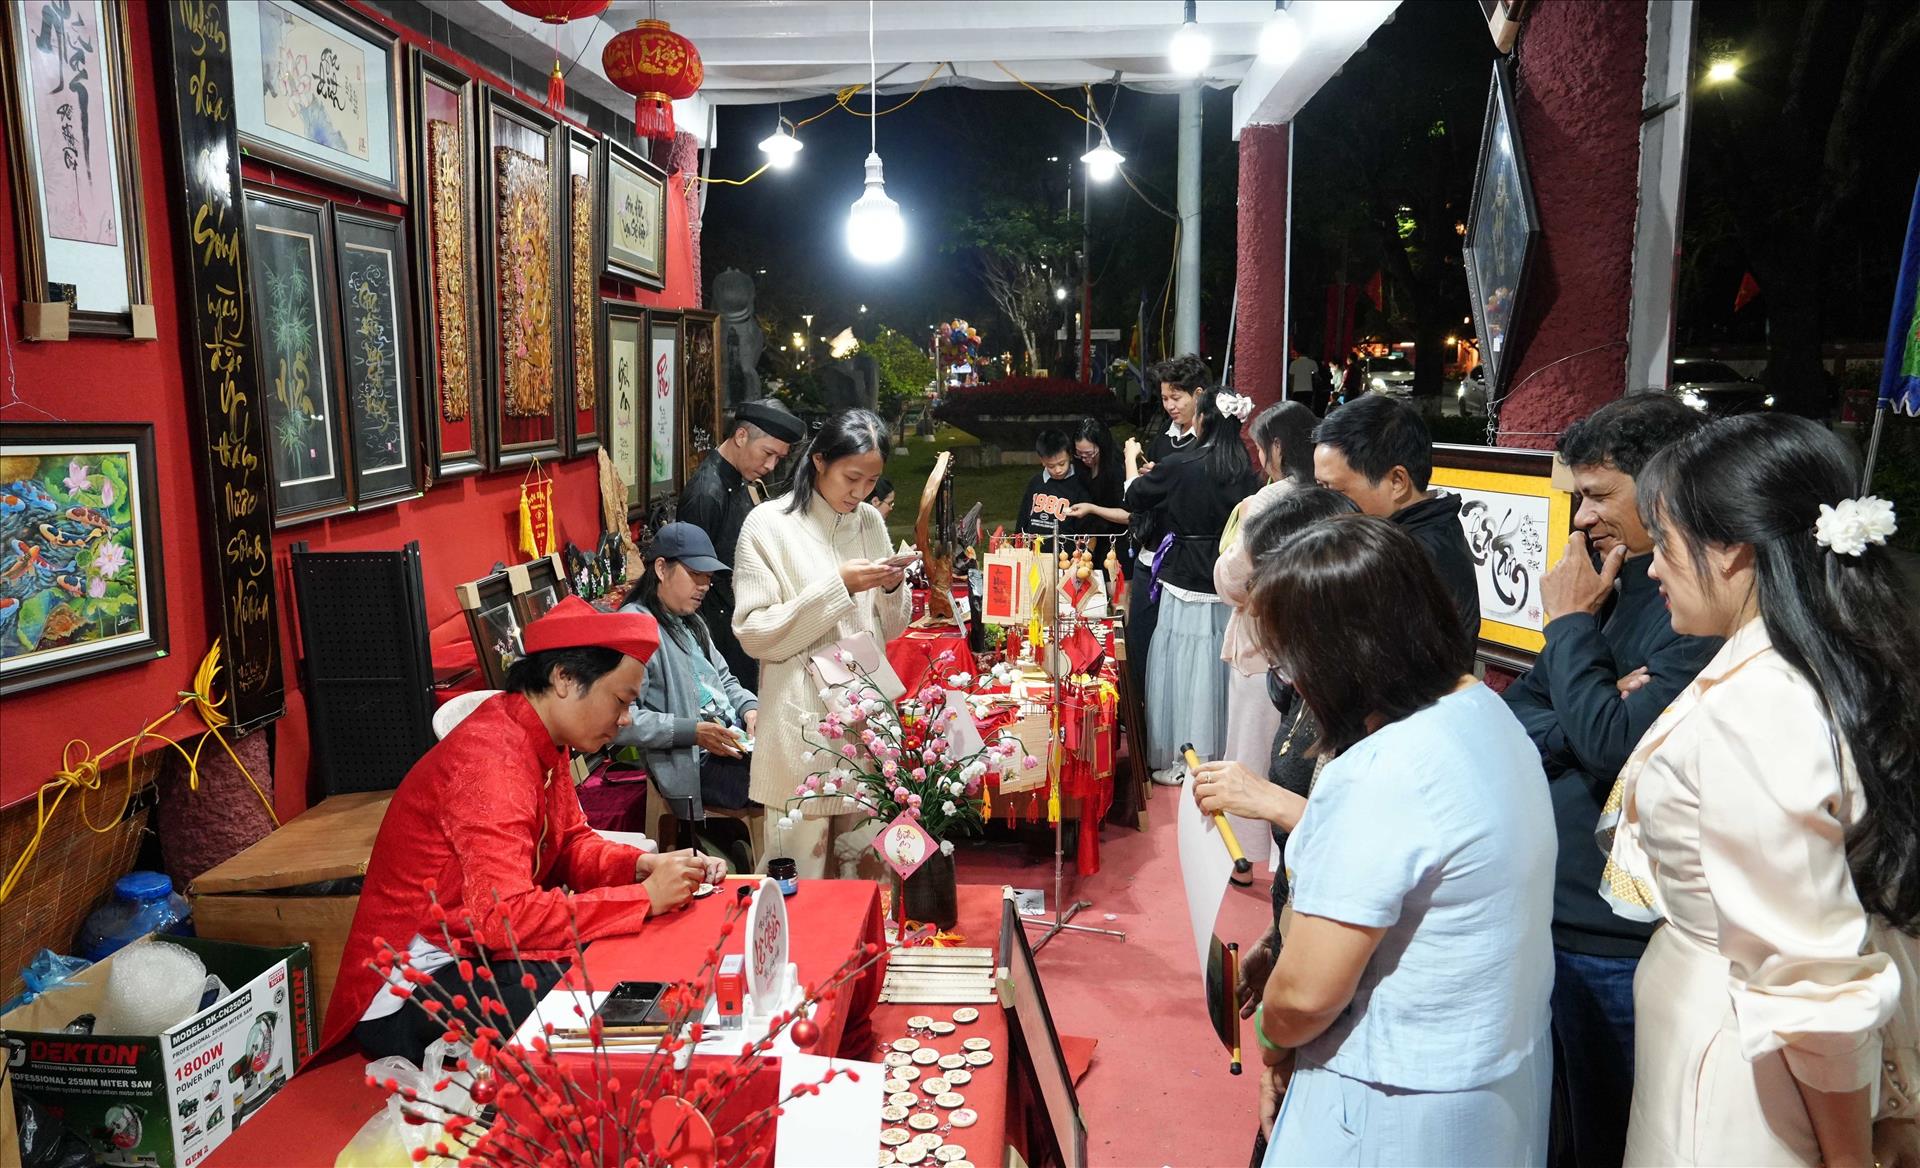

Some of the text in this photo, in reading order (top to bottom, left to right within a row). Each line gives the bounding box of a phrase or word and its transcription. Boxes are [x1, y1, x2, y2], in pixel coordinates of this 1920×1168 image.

[172, 1023, 204, 1045] MODEL:
[172, 1032, 211, 1058] PROFESSIONAL
[31, 1039, 139, 1065] DEKTON
[174, 1042, 223, 1081] 1800W
[11, 1073, 152, 1088] OFESSIONAL 255MM MITER SAW
[176, 1058, 225, 1095] POWER INPUT
[185, 1150, 203, 1167] GEN
